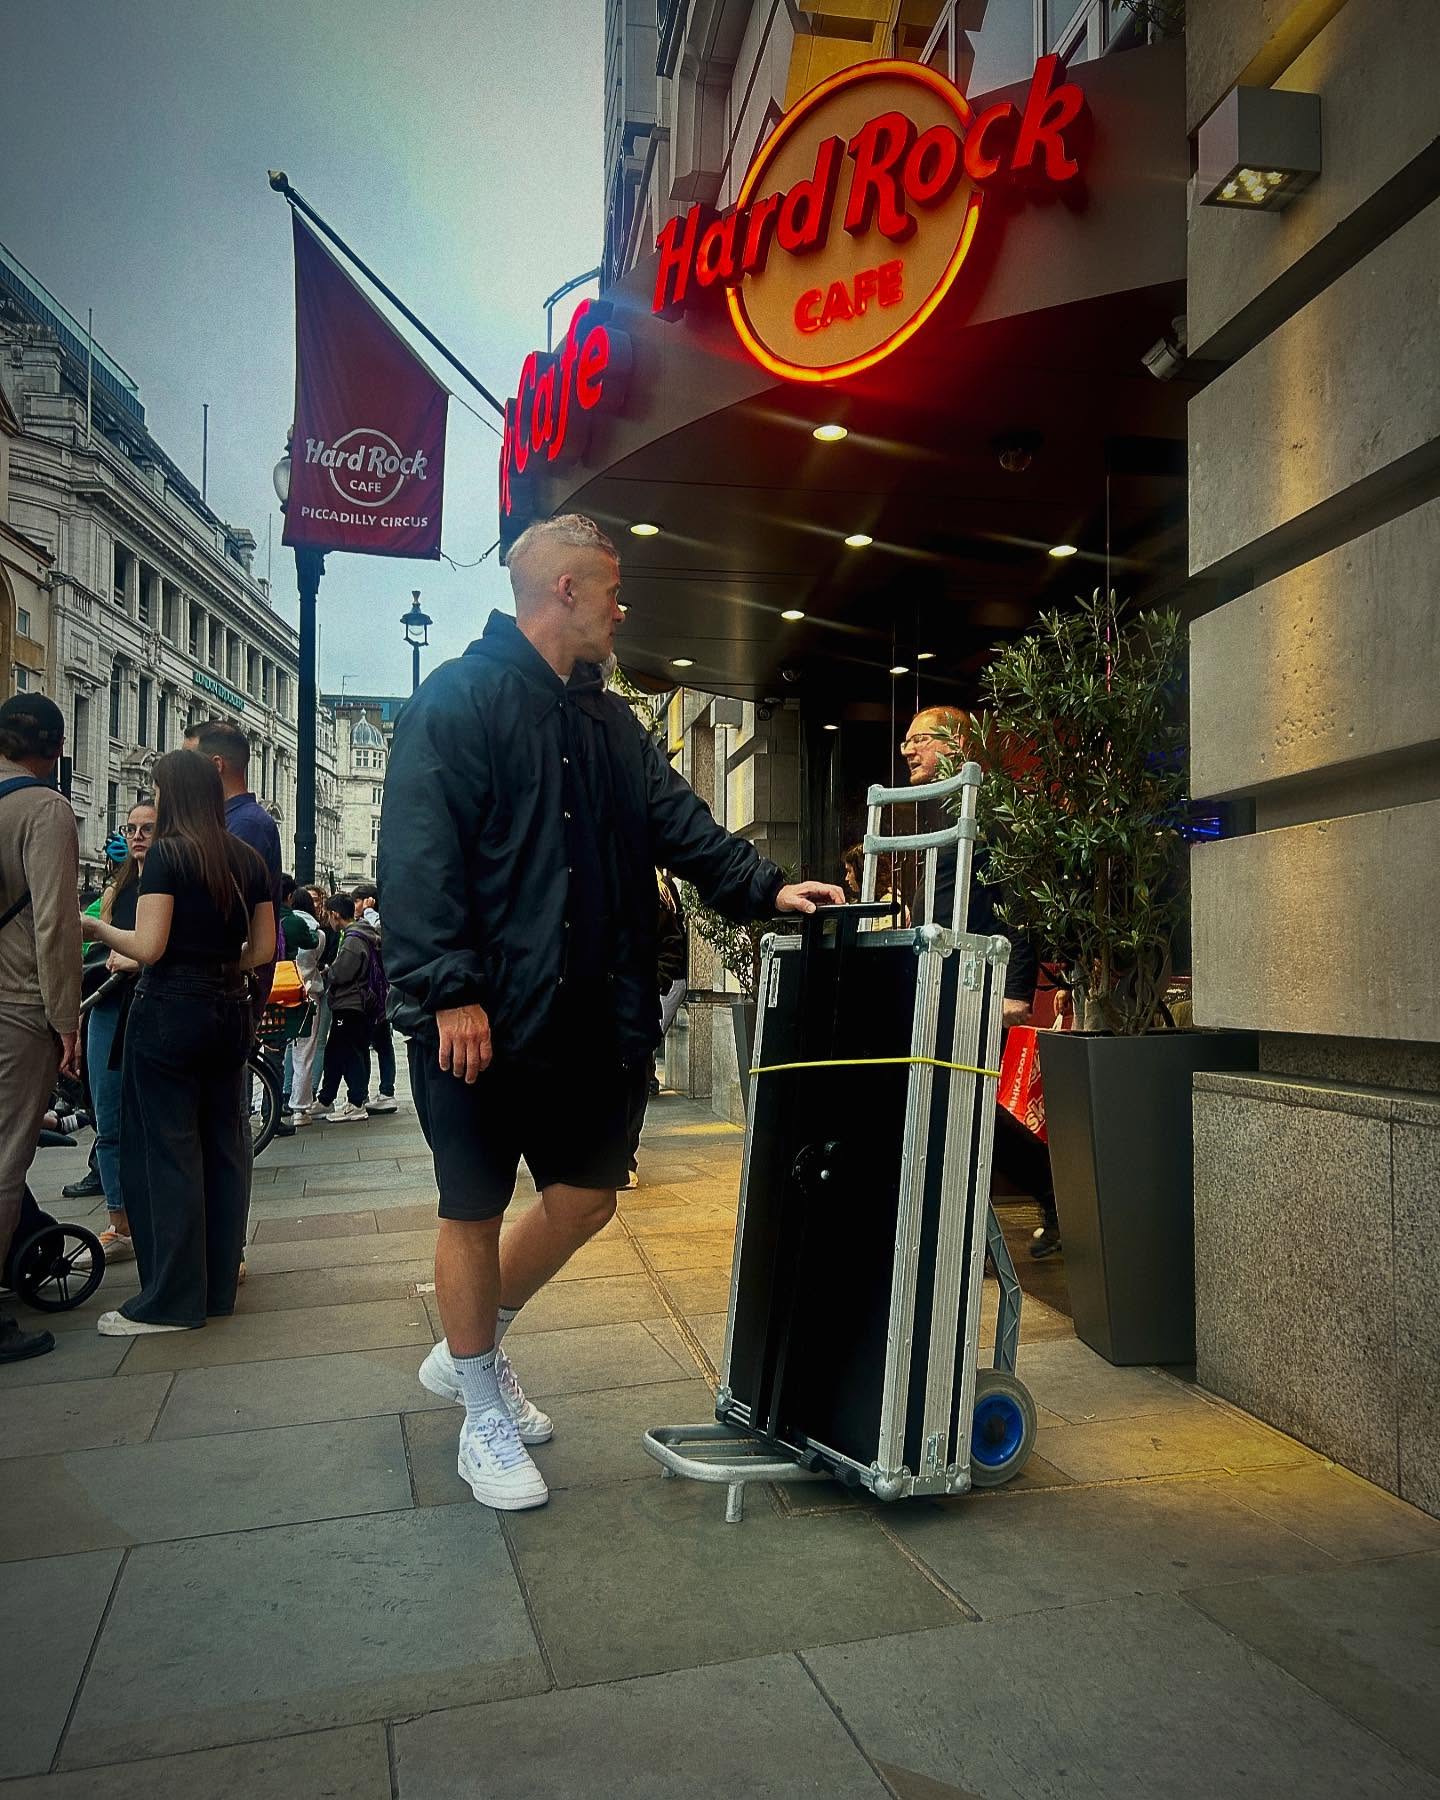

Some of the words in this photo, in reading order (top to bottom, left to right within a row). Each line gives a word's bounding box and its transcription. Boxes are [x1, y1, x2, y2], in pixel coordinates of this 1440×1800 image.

[653, 136, 845, 322] Hard
[844, 53, 1085, 240] Rock
[794, 259, 904, 333] CAFE
[514, 298, 610, 473] Cafe
[305, 438, 366, 472] Hard
[367, 446, 428, 480] Rock
[349, 479, 382, 493] CAFE
[301, 506, 377, 526] PICCADILLY
[380, 516, 428, 527] CIRCUS
